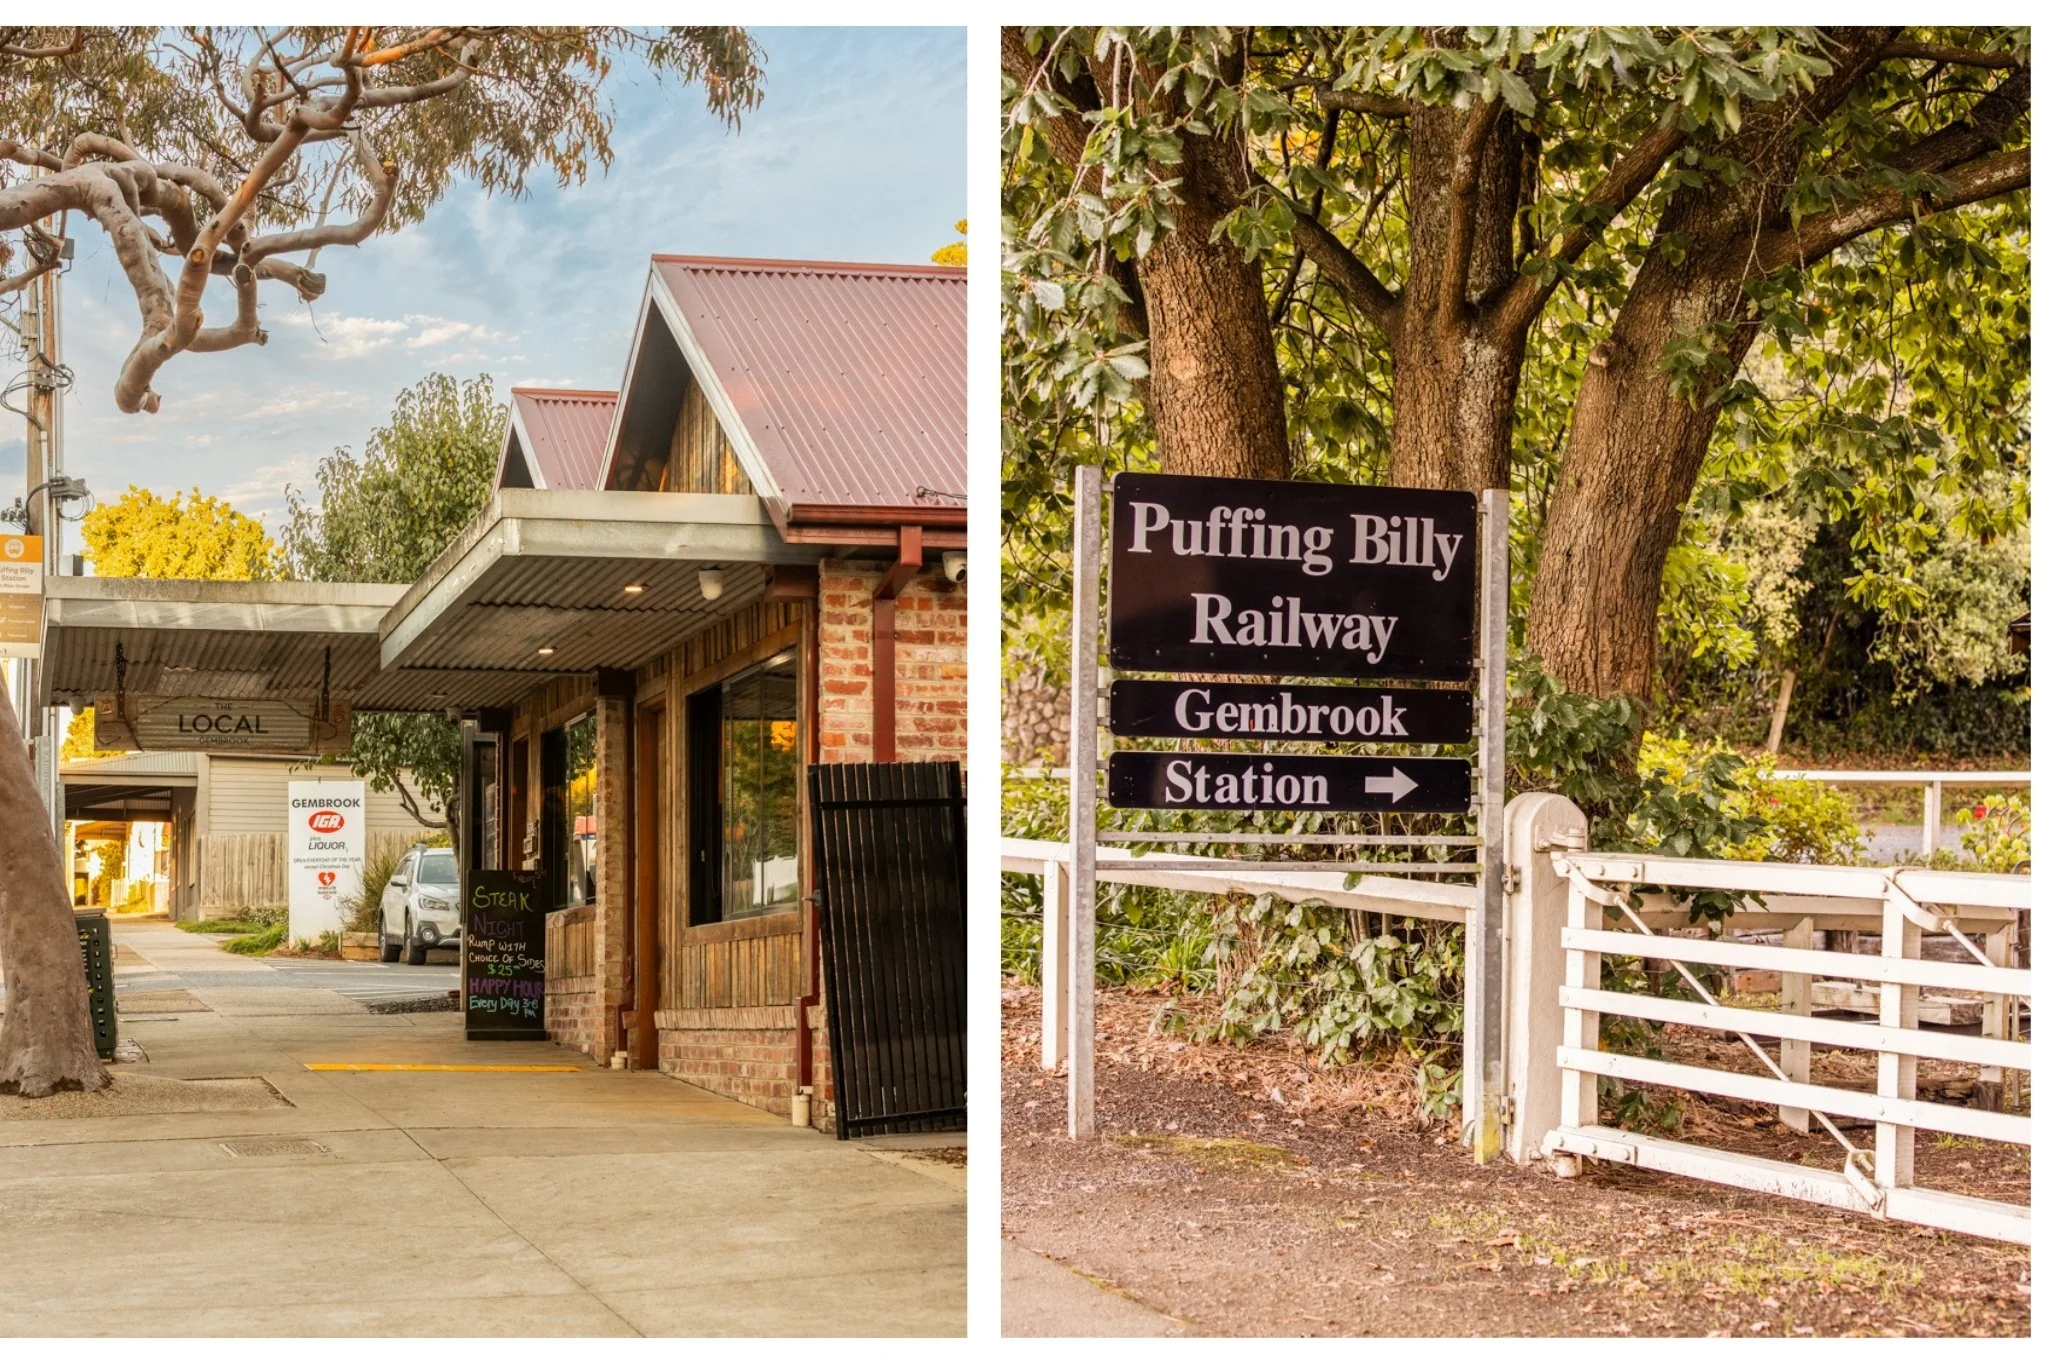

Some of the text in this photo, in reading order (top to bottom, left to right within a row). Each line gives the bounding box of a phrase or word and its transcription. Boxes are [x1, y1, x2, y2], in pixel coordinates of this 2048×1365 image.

[1128, 501, 1463, 581] Puffing Billy
[19, 567, 34, 575] Billy
[1190, 593, 1398, 664] Railway
[215, 703, 233, 711] THE
[1174, 689, 1409, 736] Gembrook
[178, 714, 269, 734] LOCAL
[199, 736, 249, 745] GEMBROOK
[1165, 760, 1330, 804] Station
[292, 798, 360, 809] GEMBROOK
[312, 814, 341, 829] IGA
[308, 841, 345, 850] LIQUOR
[472, 885, 534, 912] STEAK
[473, 912, 525, 940] NIGHT
[469, 952, 500, 963] CHOICE
[469, 978, 544, 999] HAPPY HOUR
[469, 995, 498, 1013] Every
[500, 996, 520, 1015] Day
